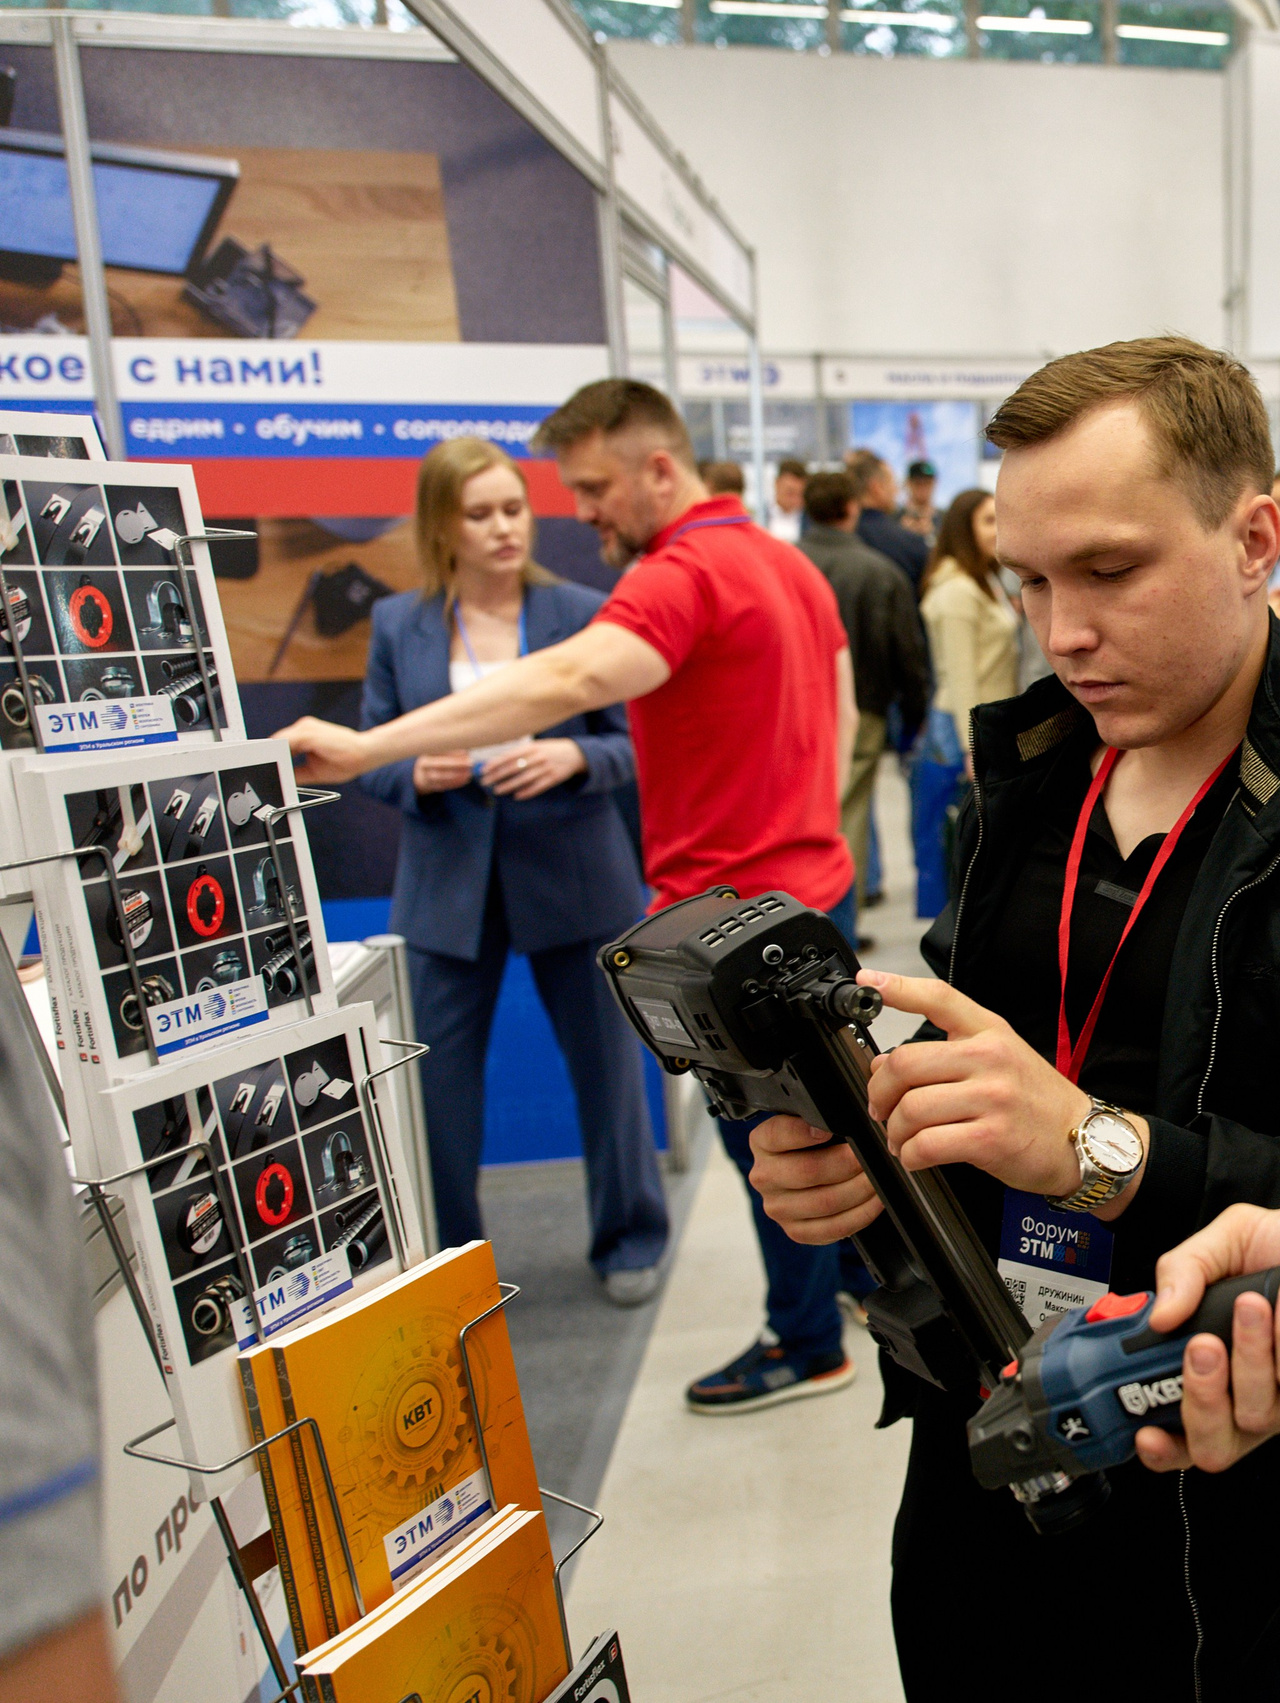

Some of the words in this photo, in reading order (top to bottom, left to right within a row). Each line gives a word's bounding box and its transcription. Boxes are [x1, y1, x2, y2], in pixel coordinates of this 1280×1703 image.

[129, 357, 155, 384] с
[176, 349, 323, 385] нами!
[256, 413, 363, 447] обучим
[48, 711, 99, 733] ЭТМ
[52, 996, 63, 1035] Fortisflex
[73, 1009, 84, 1048] Fortisflex
[84, 1011, 96, 1050] Fortisflex
[156, 1003, 202, 1032] ЭТМ
[1021, 1215, 1079, 1244] Форум
[1020, 1236, 1055, 1260] ЭТМ
[242, 1287, 286, 1324] ЭТМ
[1038, 1286, 1085, 1305] ДРУЖИНИН
[1044, 1301, 1073, 1314] Макси
[156, 1323, 169, 1361] Fortisflex
[403, 1398, 432, 1430] КВТ
[394, 1514, 434, 1554] ЭТМ
[112, 1554, 149, 1630] по
[285, 1581, 300, 1629] АРМАТУРА
[317, 1569, 332, 1616] АРМАТУРА
